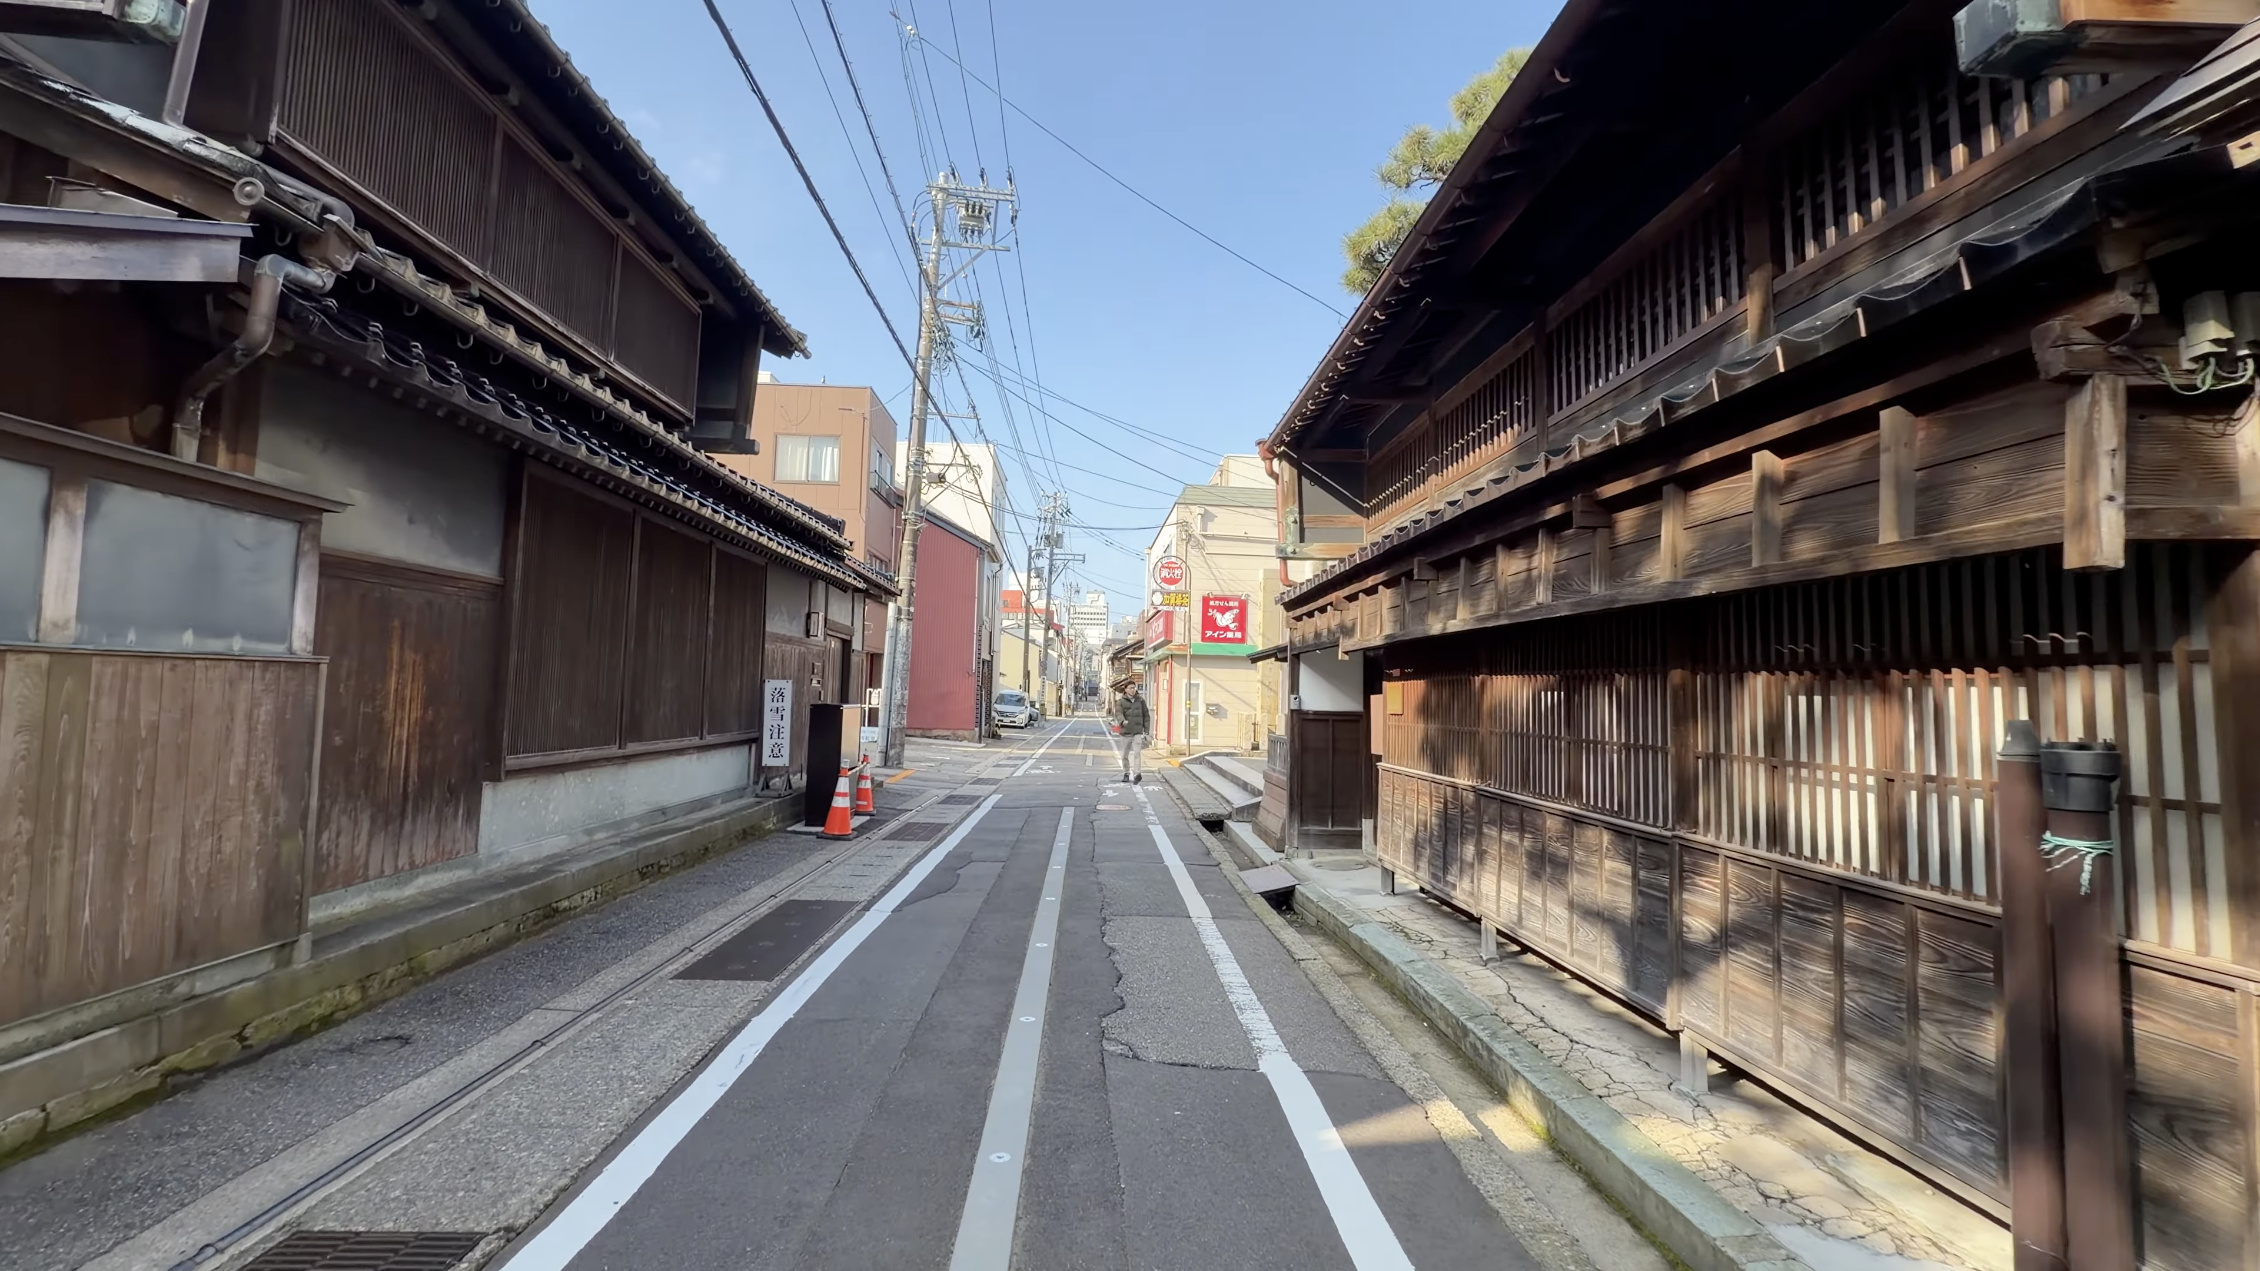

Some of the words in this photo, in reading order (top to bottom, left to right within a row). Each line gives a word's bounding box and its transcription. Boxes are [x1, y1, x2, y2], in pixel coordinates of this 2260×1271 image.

[1160, 567, 1183, 579] 消火栓
[1205, 630, 1242, 639] アイン薬局
[768, 687, 786, 759] 落雪注意
